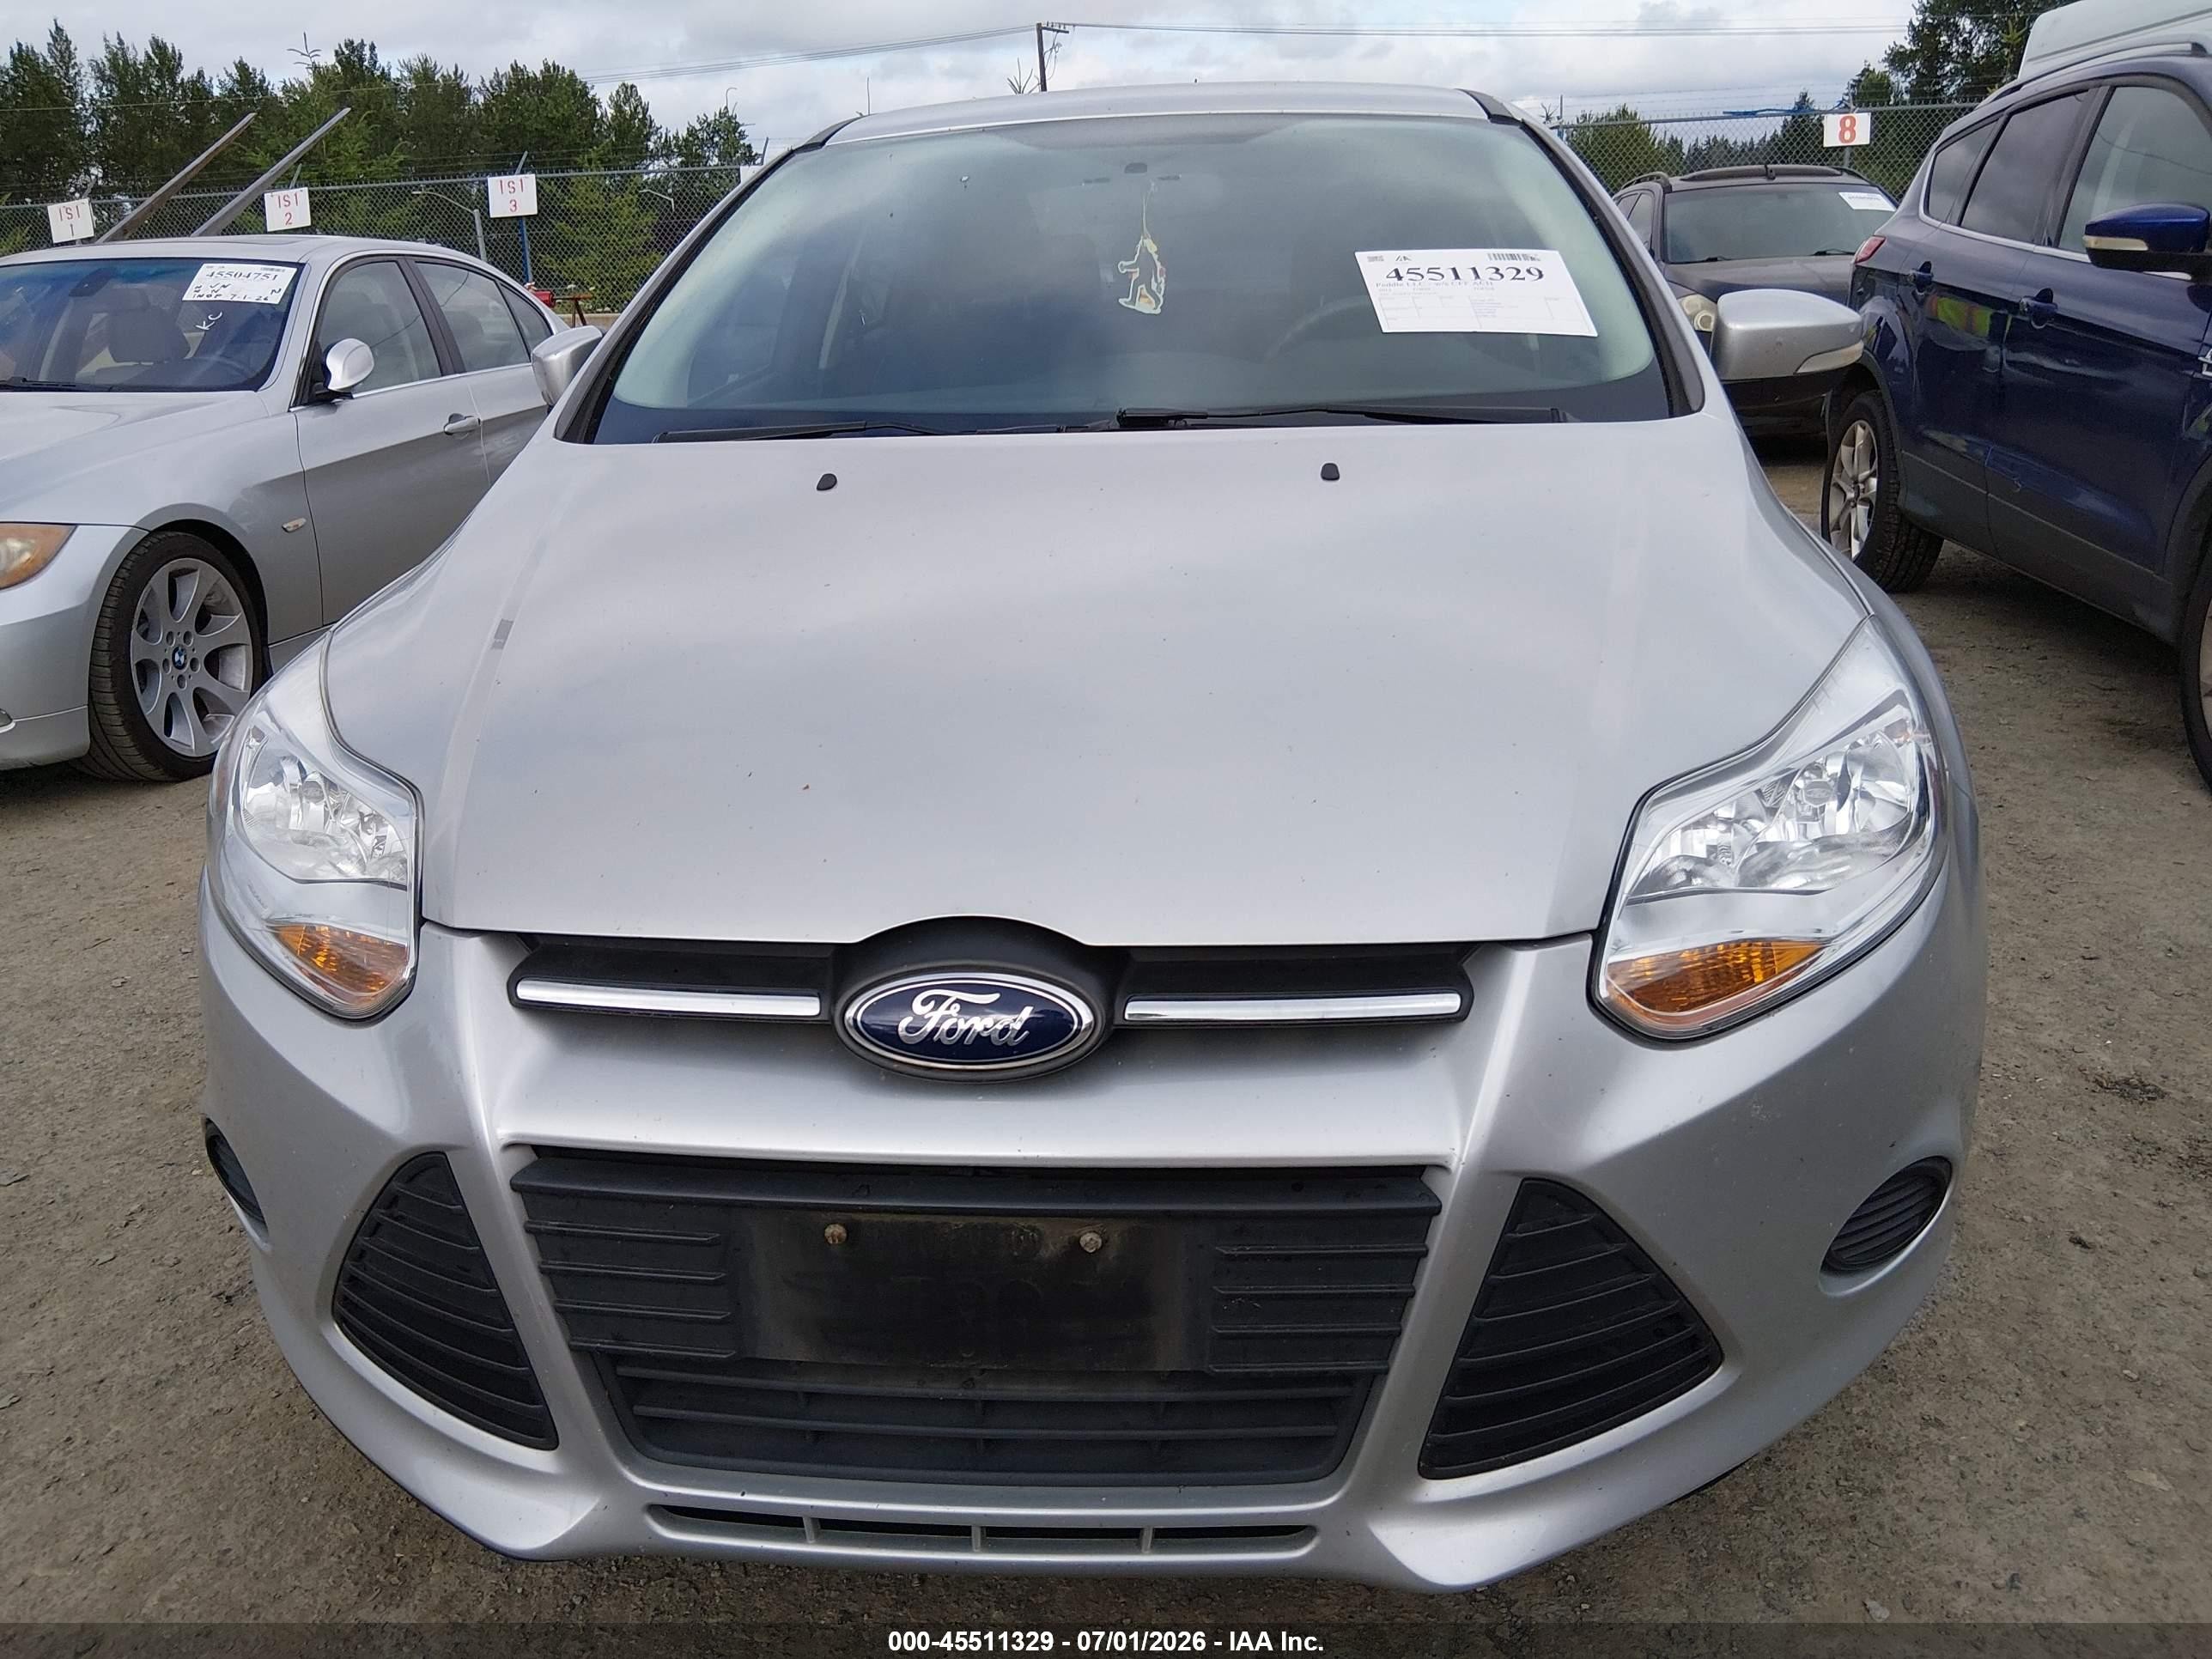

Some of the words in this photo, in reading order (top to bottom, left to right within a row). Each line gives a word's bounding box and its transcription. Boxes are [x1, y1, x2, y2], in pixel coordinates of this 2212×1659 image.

[1838, 115, 1856, 144] 8
[509, 199, 517, 212] 3
[284, 212, 293, 226] 2
[1386, 266, 1544, 282] 45511329
[898, 989, 1035, 1046] Ford
